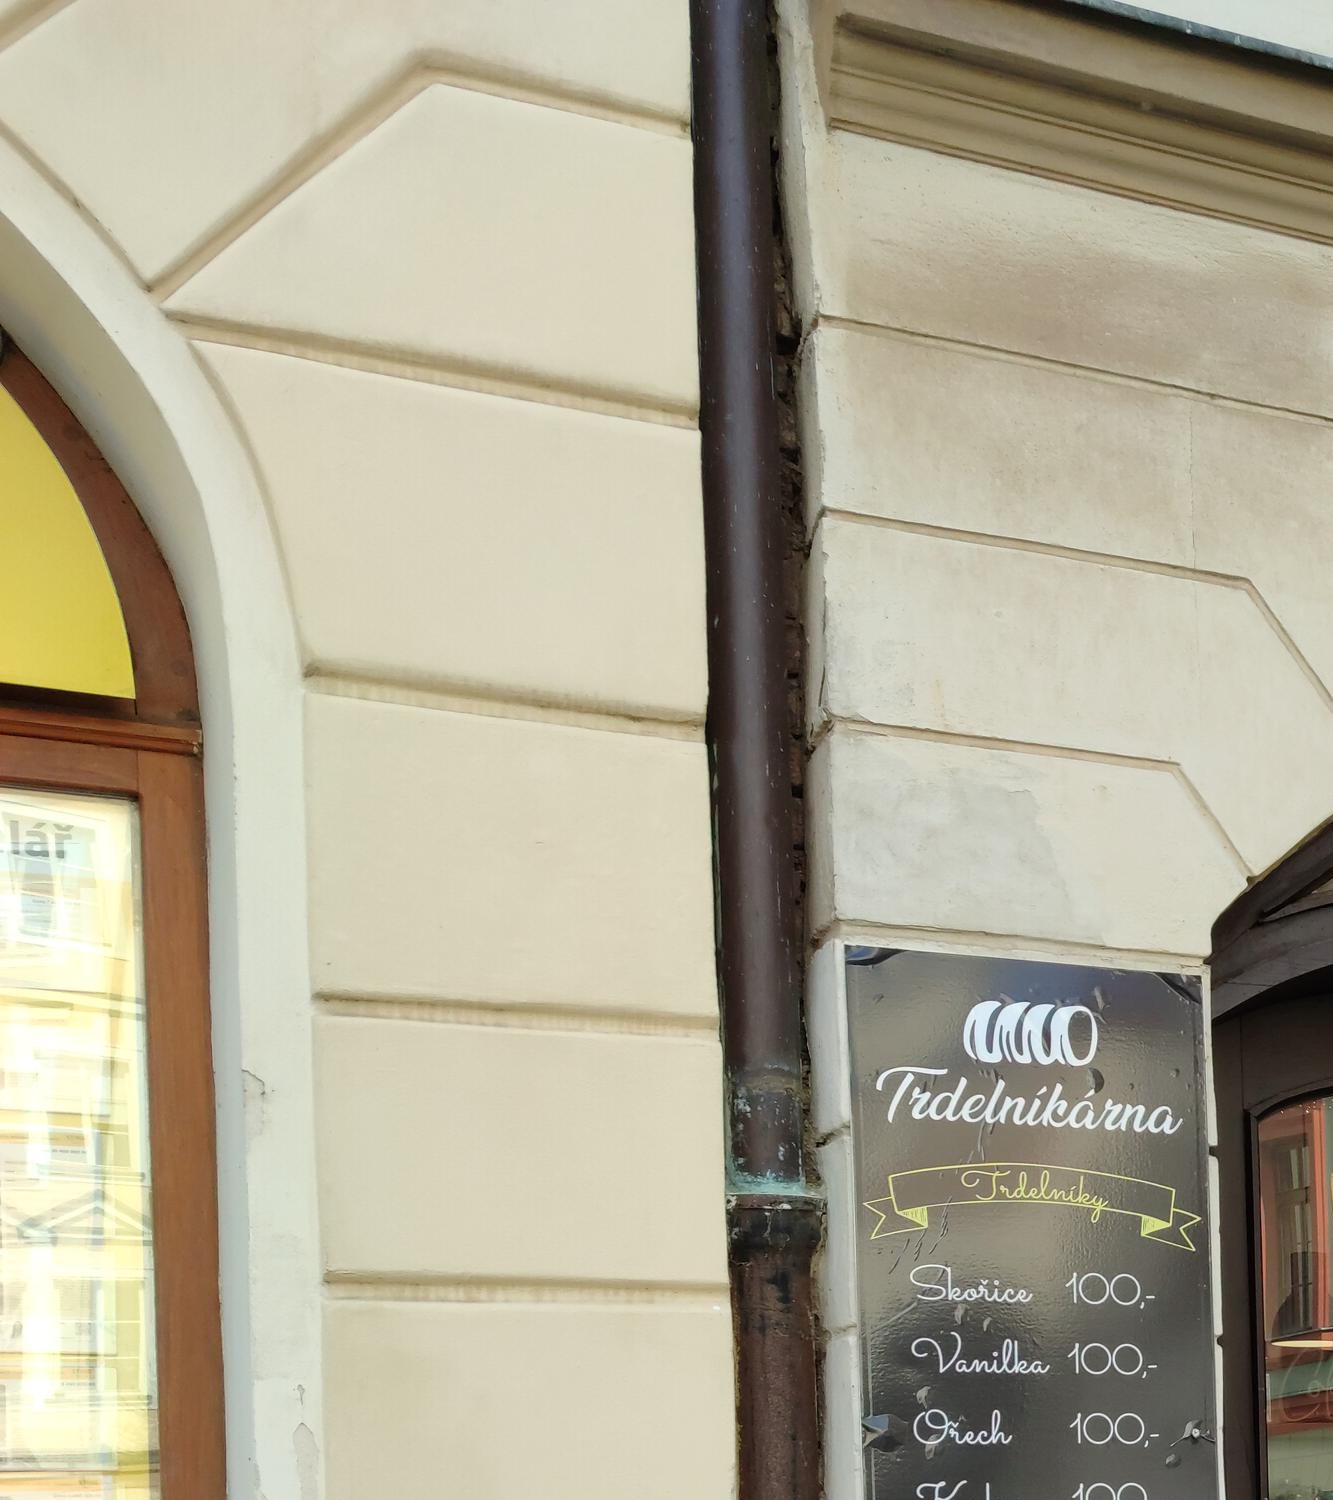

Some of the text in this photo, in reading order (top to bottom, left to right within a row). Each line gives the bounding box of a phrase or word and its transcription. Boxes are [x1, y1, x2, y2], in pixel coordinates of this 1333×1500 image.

[876, 1066, 1184, 1135] Trdelníkárna
[961, 1169, 1109, 1224] Trdelníky
[909, 1264, 1156, 1310] Skořice 100,-
[911, 1332, 1158, 1380] Vanilka 100,-
[913, 1409, 1160, 1448] Ořech 100,-
